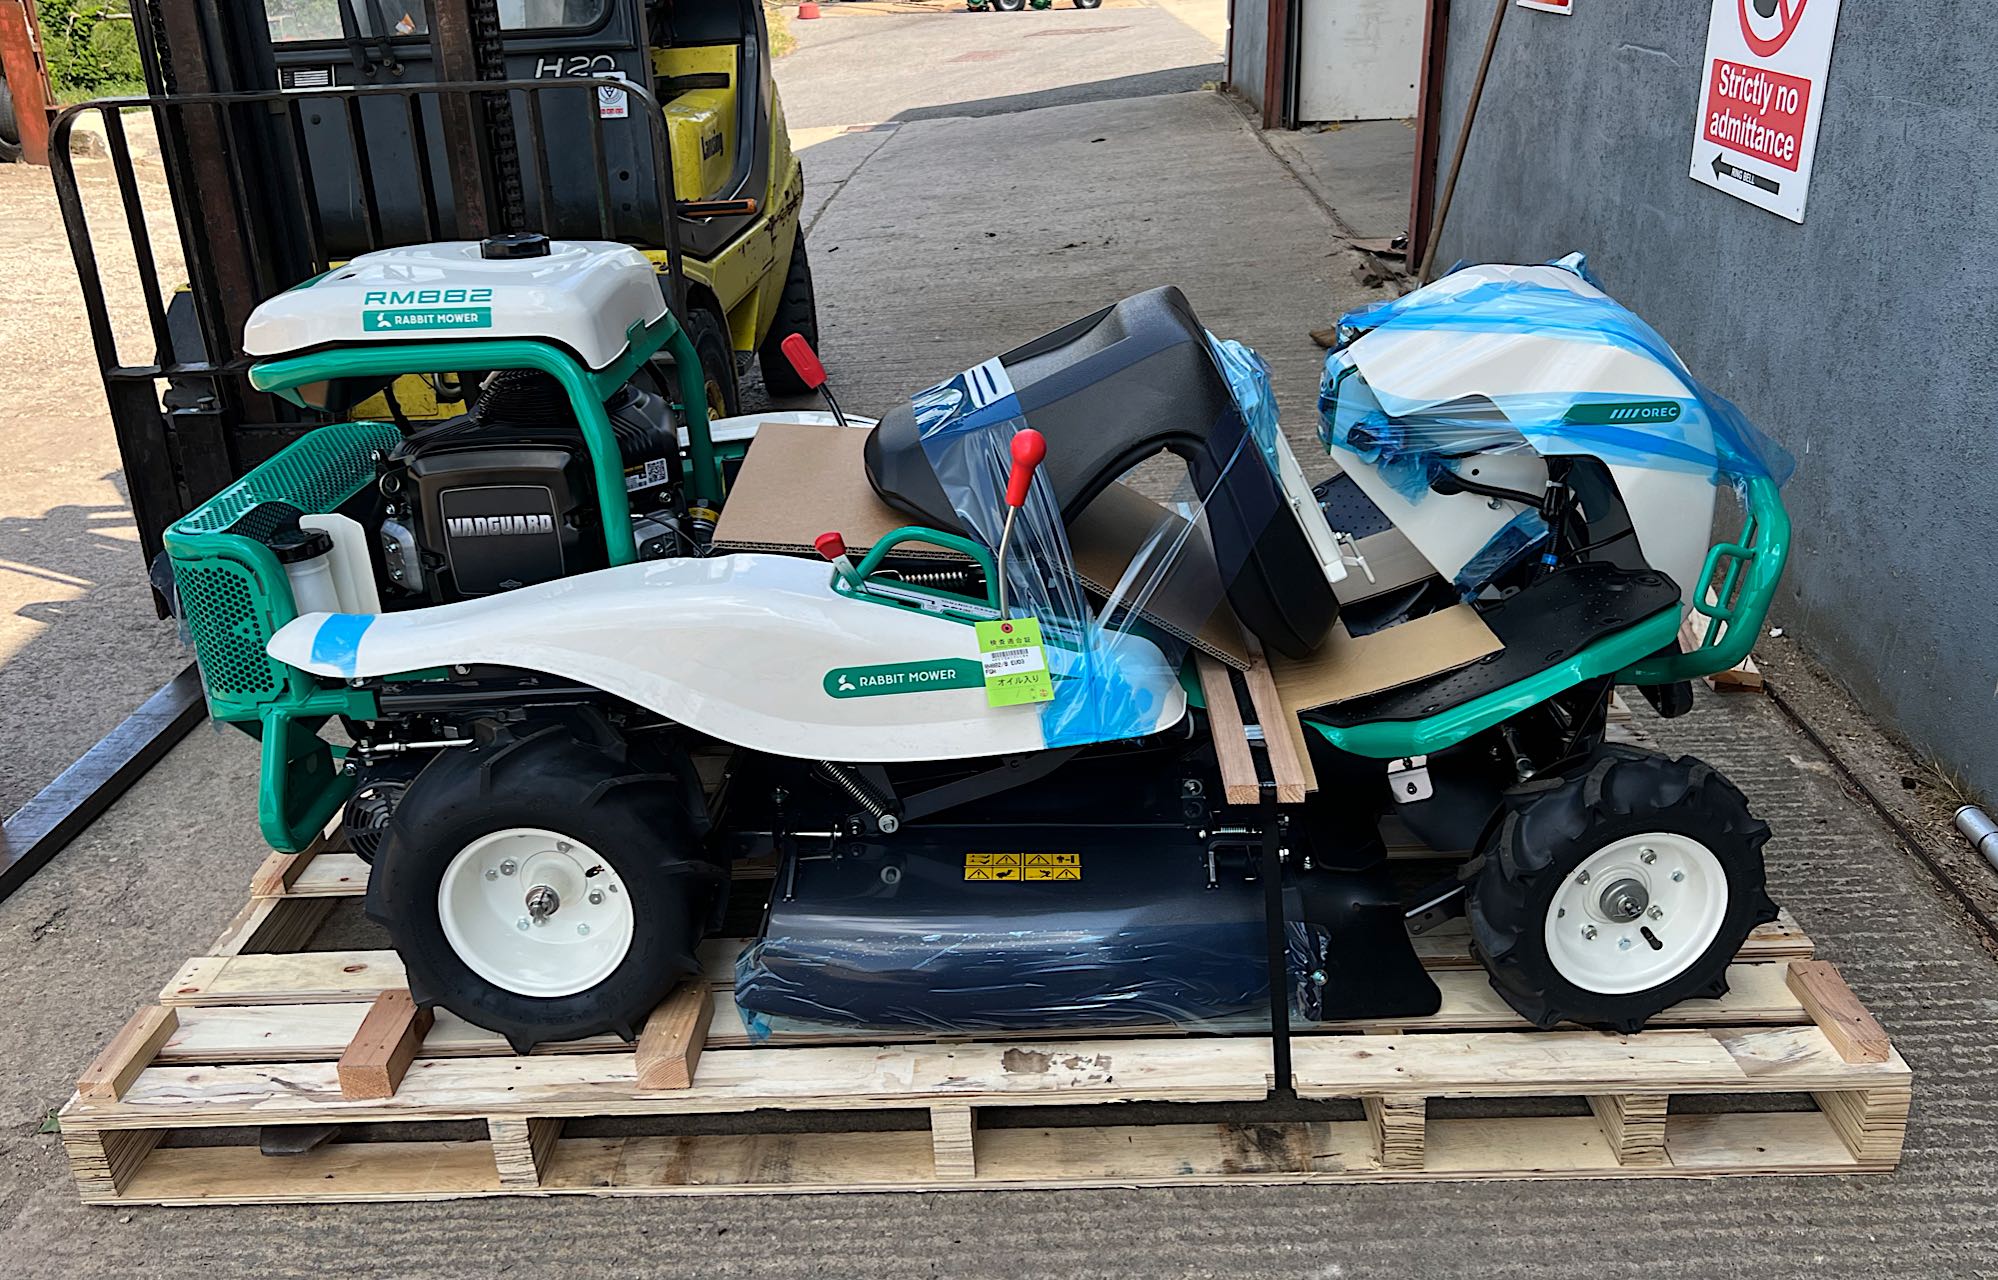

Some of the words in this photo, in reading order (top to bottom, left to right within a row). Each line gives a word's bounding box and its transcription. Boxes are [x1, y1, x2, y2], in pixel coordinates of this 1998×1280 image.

[1718, 63, 1774, 116] Strictly
[1775, 85, 1799, 115] no
[1709, 108, 1795, 161] admittance
[1730, 167, 1743, 180] RING
[1742, 170, 1756, 185] BELL
[364, 288, 493, 305] RM882
[394, 314, 435, 325] RABBIT
[437, 313, 479, 324] MOWER
[1641, 407, 1677, 418] OREC
[446, 514, 554, 538] VANGUARD
[859, 673, 906, 687] RABBIT
[908, 669, 957, 683] MOWER
[997, 674, 1040, 687] オイル入り
